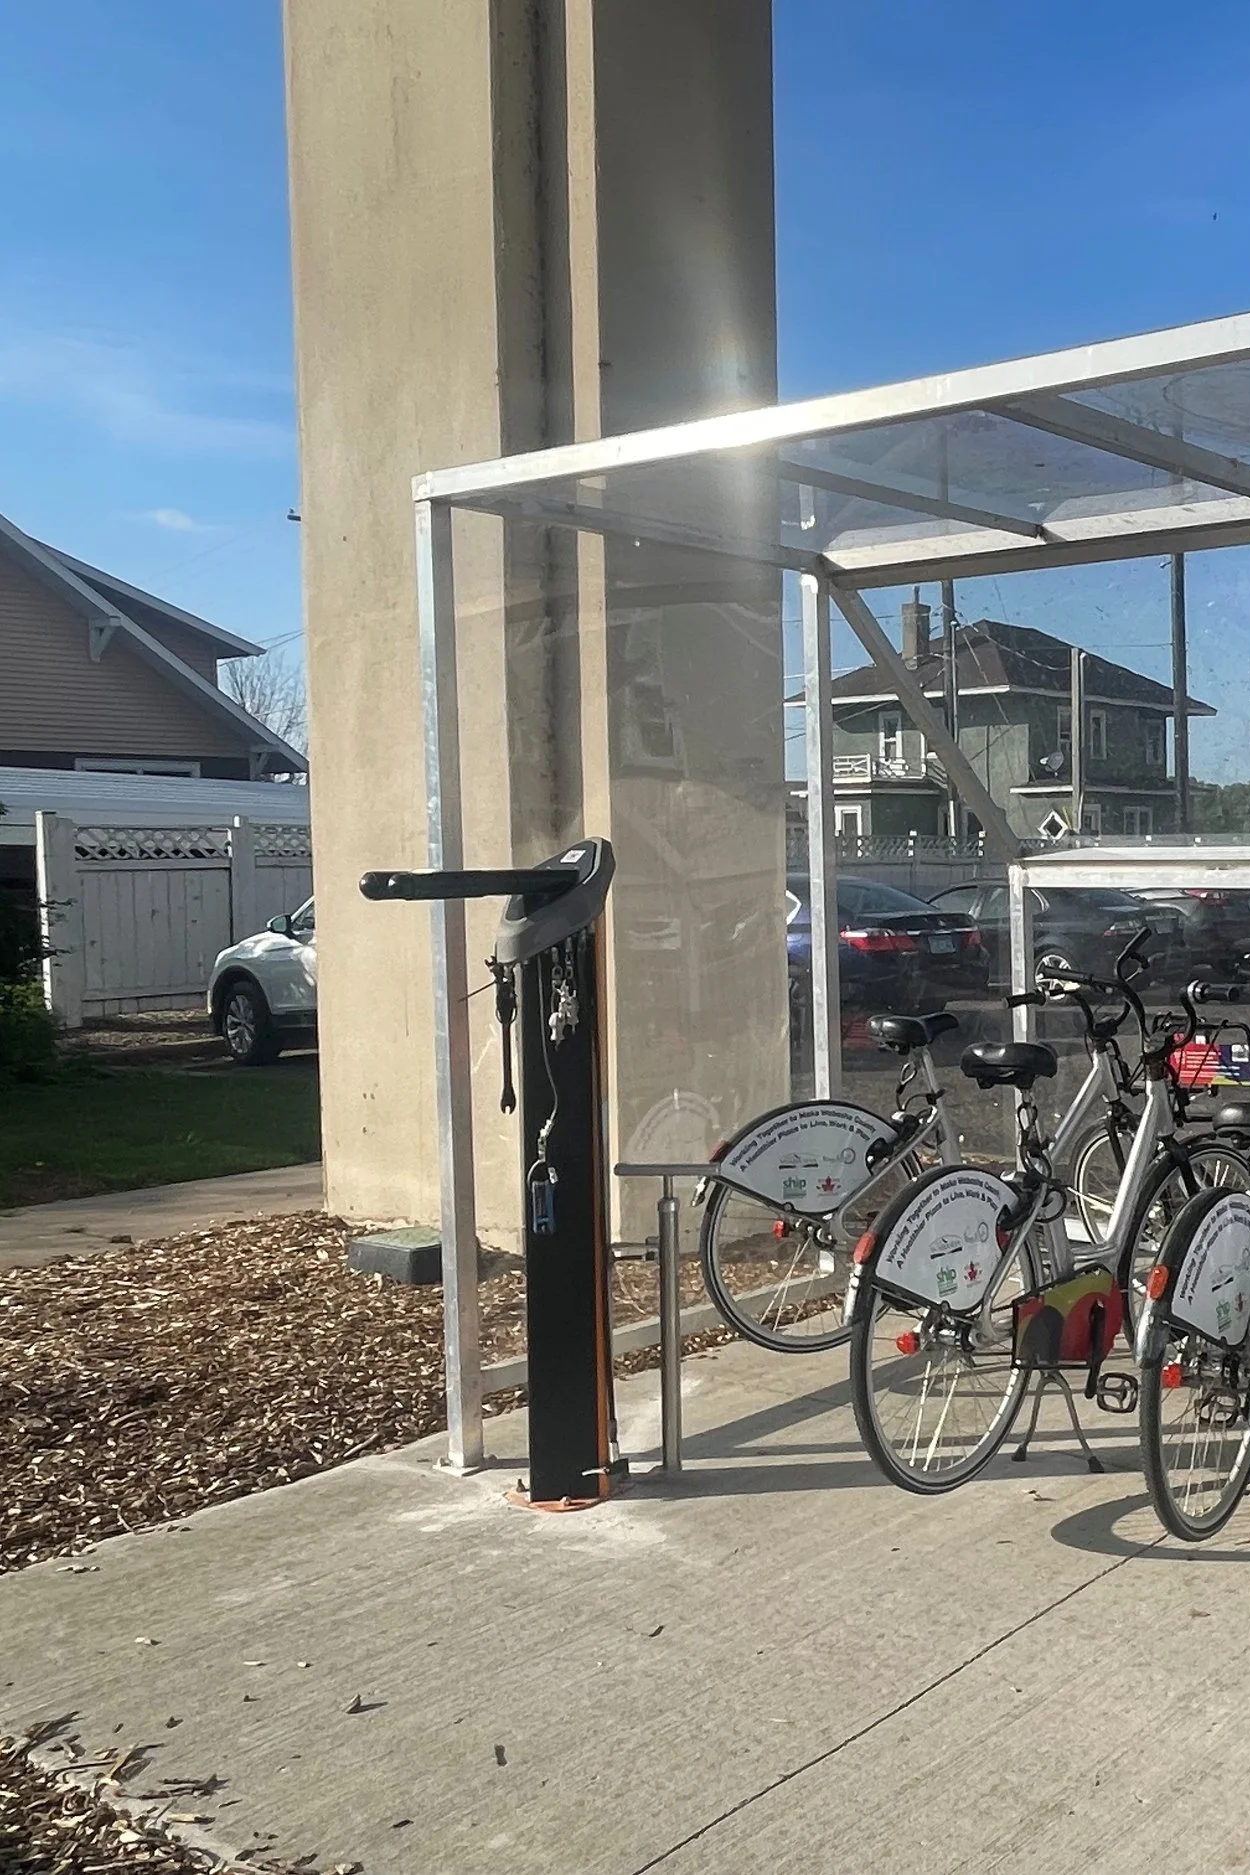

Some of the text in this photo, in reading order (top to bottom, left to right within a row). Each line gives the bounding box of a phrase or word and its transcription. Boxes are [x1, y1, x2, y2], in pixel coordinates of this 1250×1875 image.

[729, 1139, 758, 1166] Working
[756, 1118, 788, 1140] Together
[886, 1225, 910, 1263] Working
[907, 1193, 933, 1224] Together
